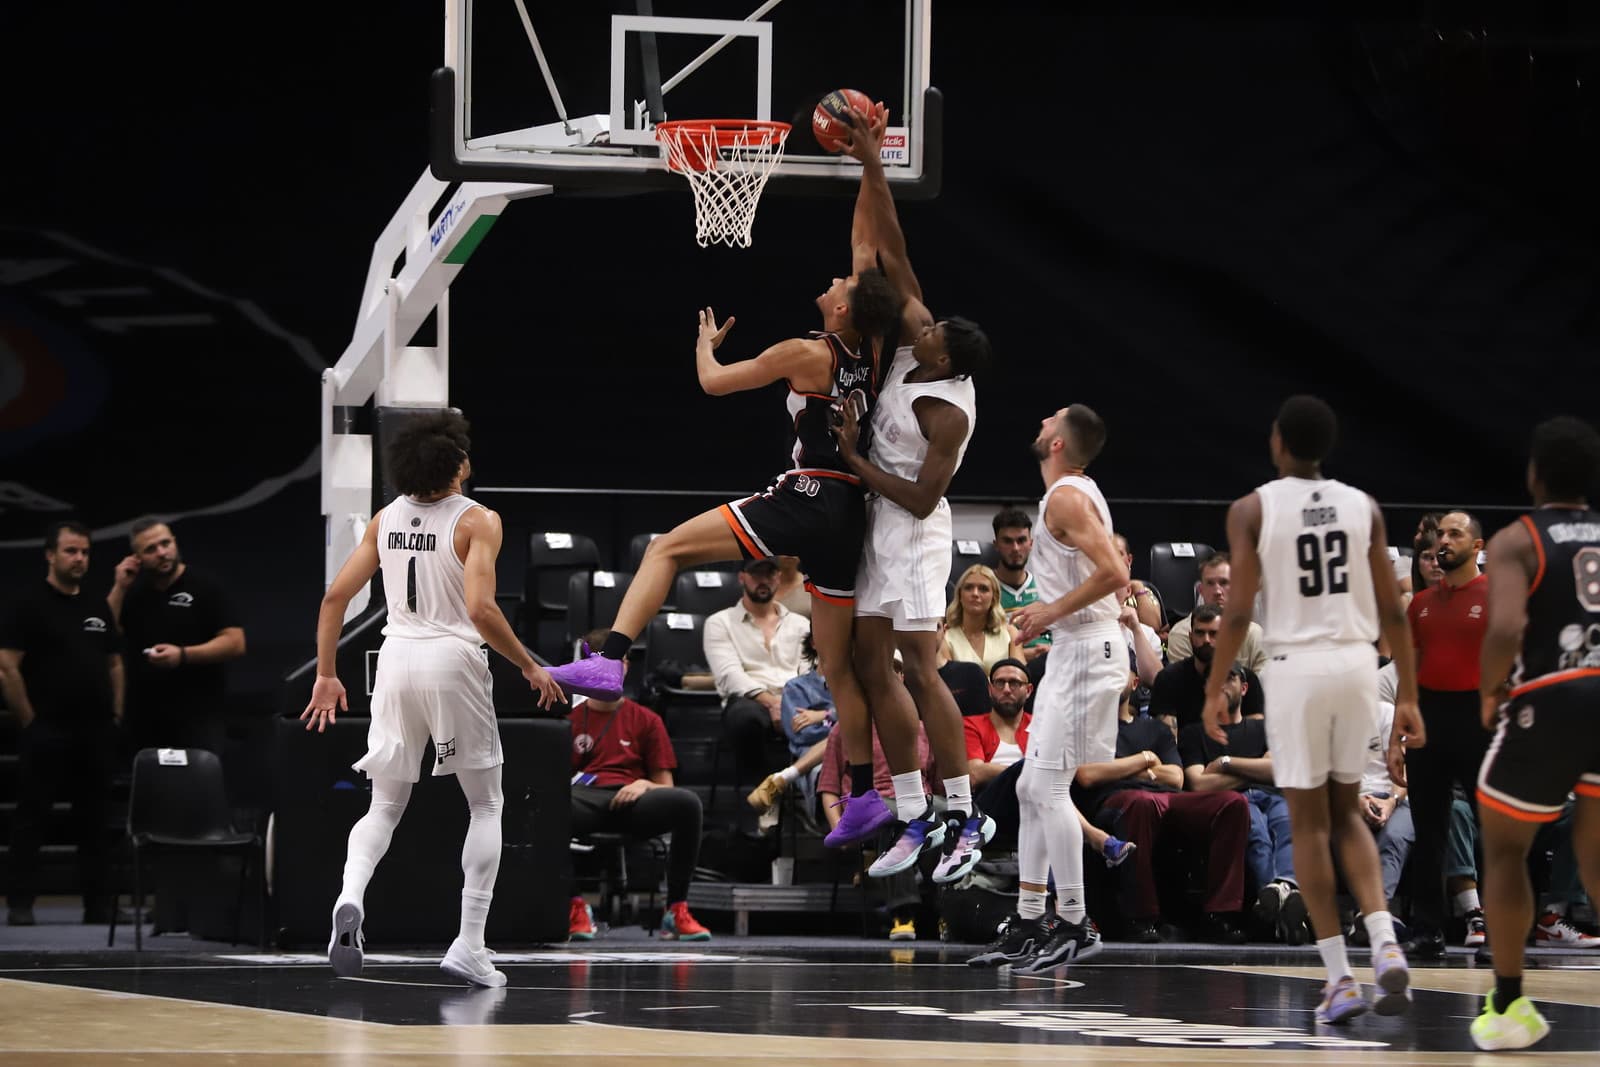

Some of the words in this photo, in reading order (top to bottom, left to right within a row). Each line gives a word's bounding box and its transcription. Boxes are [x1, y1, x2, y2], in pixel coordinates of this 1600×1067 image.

[881, 150, 903, 160] LITE
[794, 473, 821, 497] 30
[1296, 530, 1349, 598] 92
[407, 556, 417, 614] 1
[1104, 641, 1111, 659] 9
